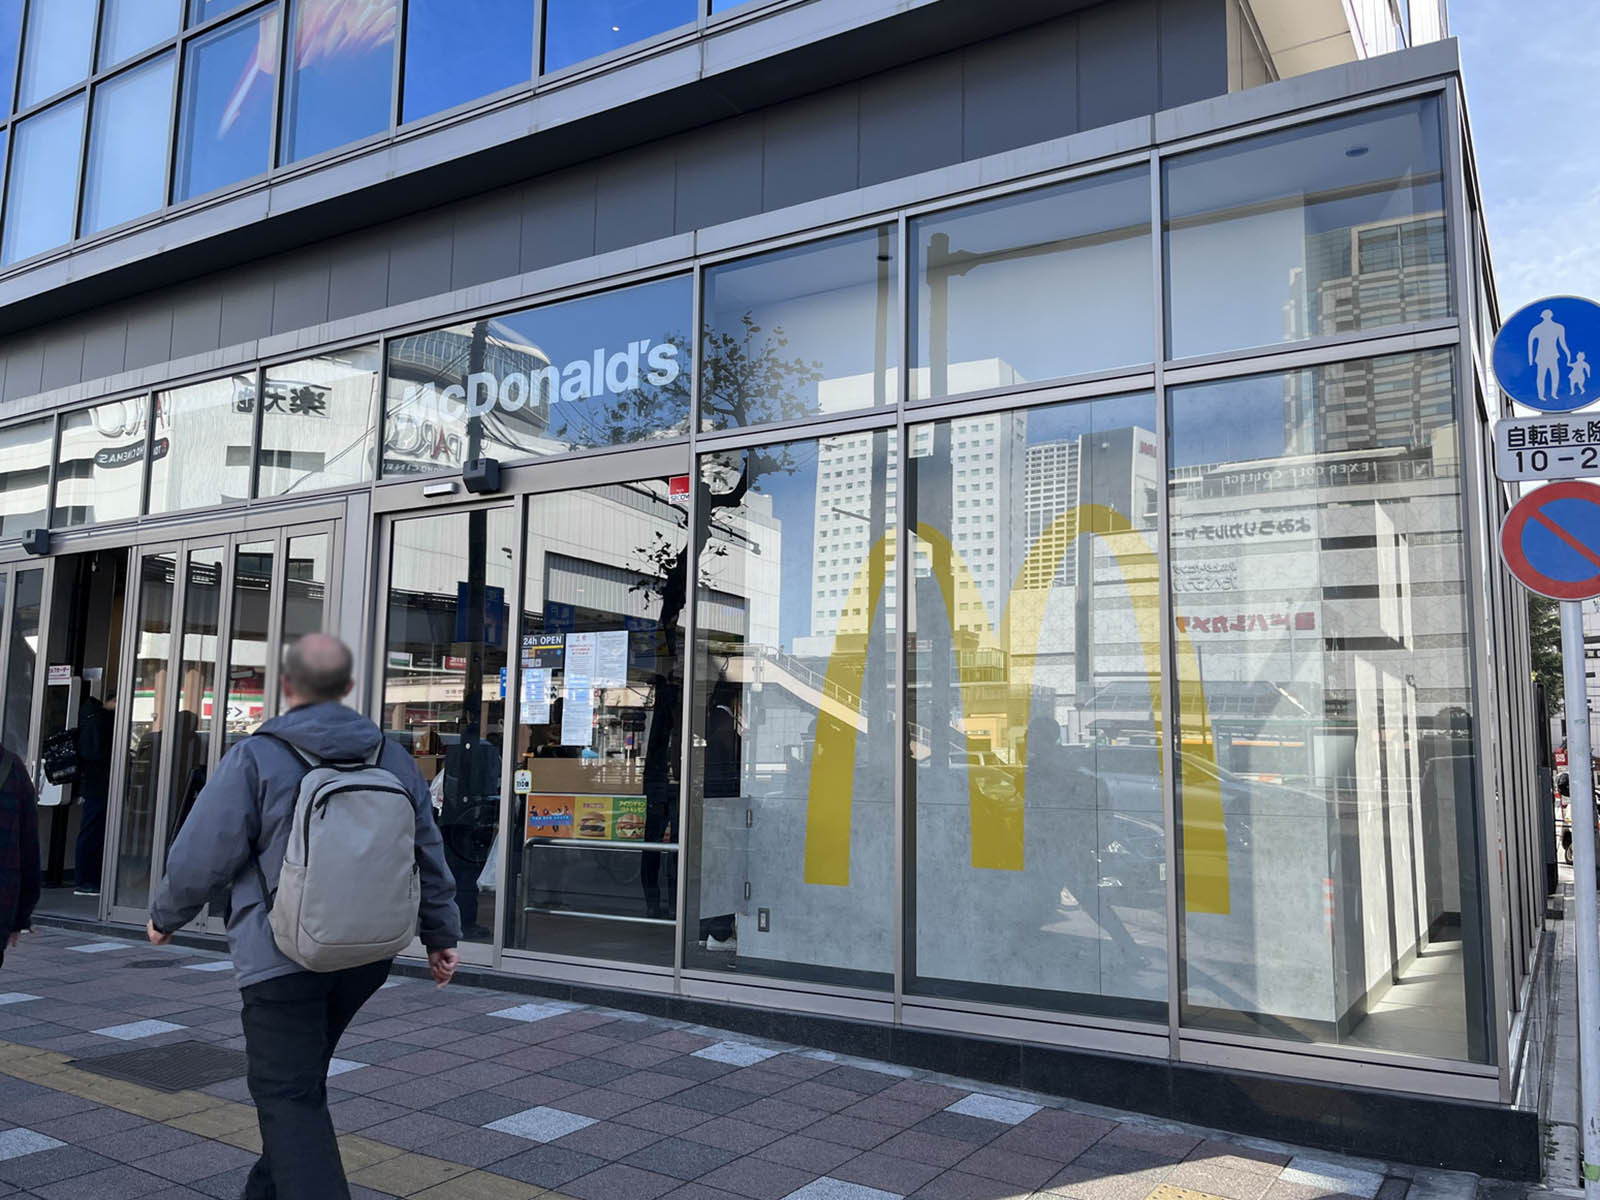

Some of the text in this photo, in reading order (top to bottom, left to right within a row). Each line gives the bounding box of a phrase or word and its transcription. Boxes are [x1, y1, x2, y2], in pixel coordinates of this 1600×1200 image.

[403, 338, 680, 421] McDonald's
[523, 636, 562, 646] 24h OPEN
